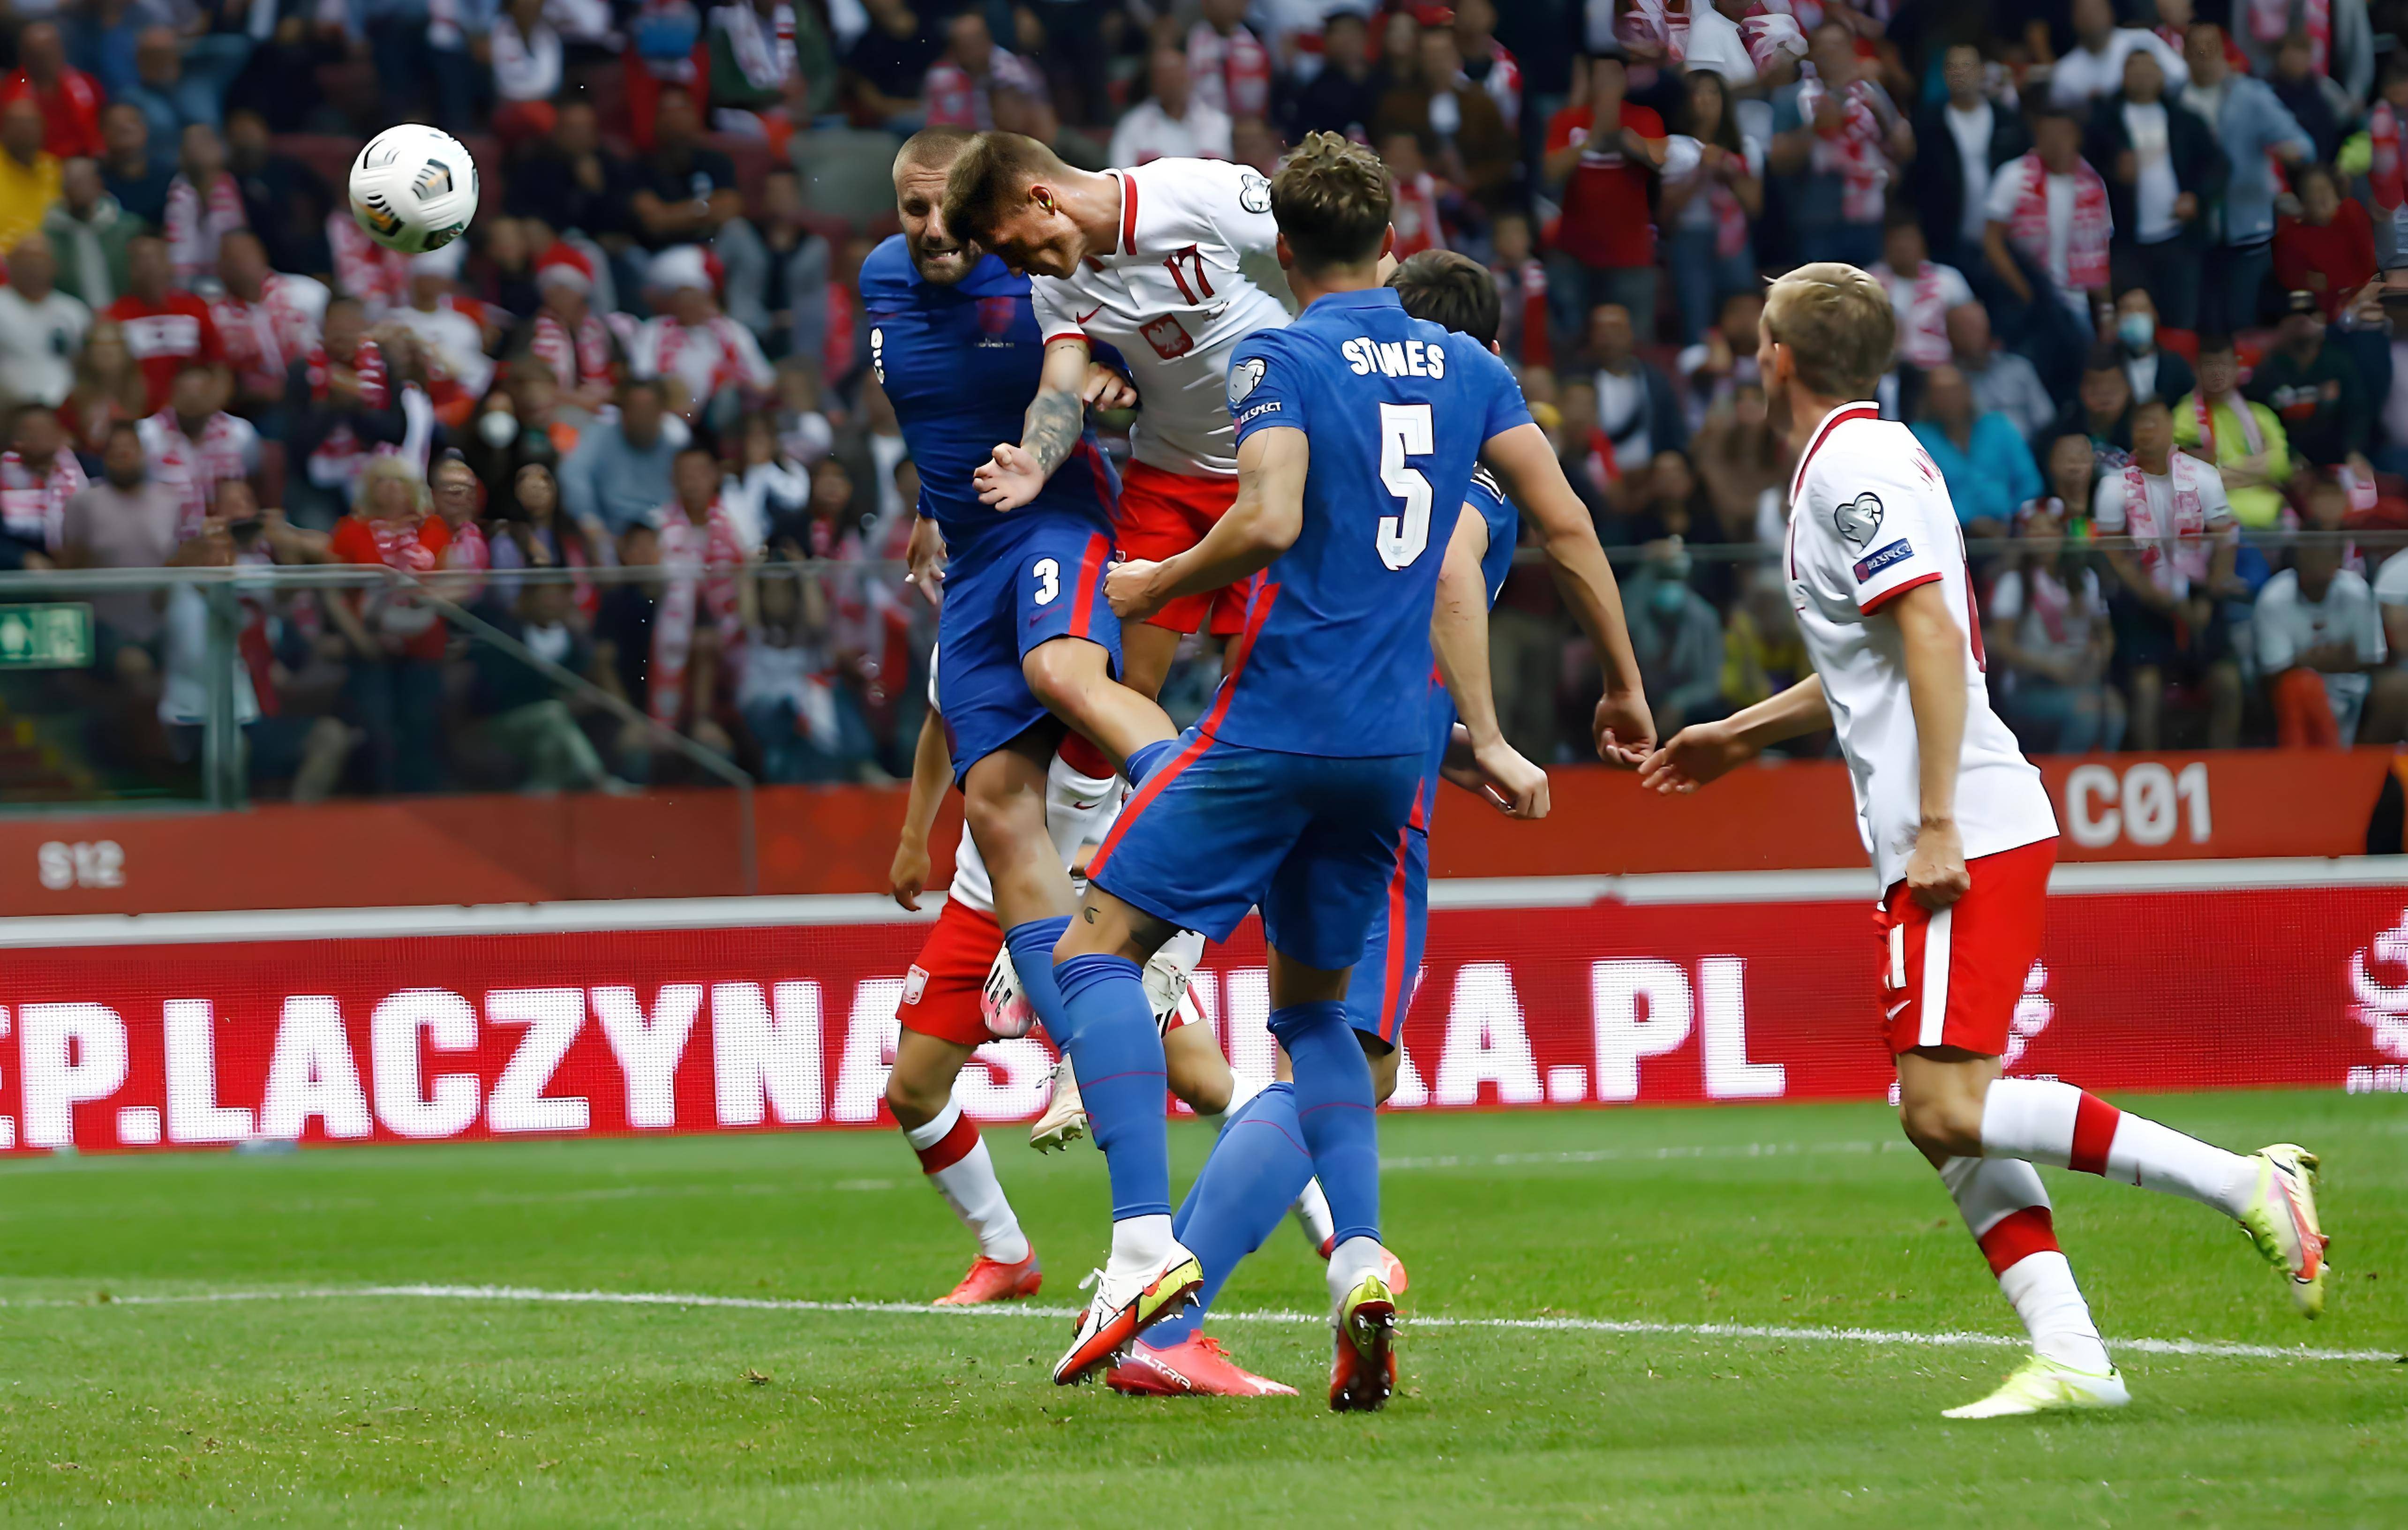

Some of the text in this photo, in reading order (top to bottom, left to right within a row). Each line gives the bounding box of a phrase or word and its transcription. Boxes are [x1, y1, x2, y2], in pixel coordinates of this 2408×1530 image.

[1162, 242, 1215, 306] 17
[1376, 402, 1434, 570] 5
[1033, 558, 1060, 606] 3
[38, 840, 126, 890] S12
